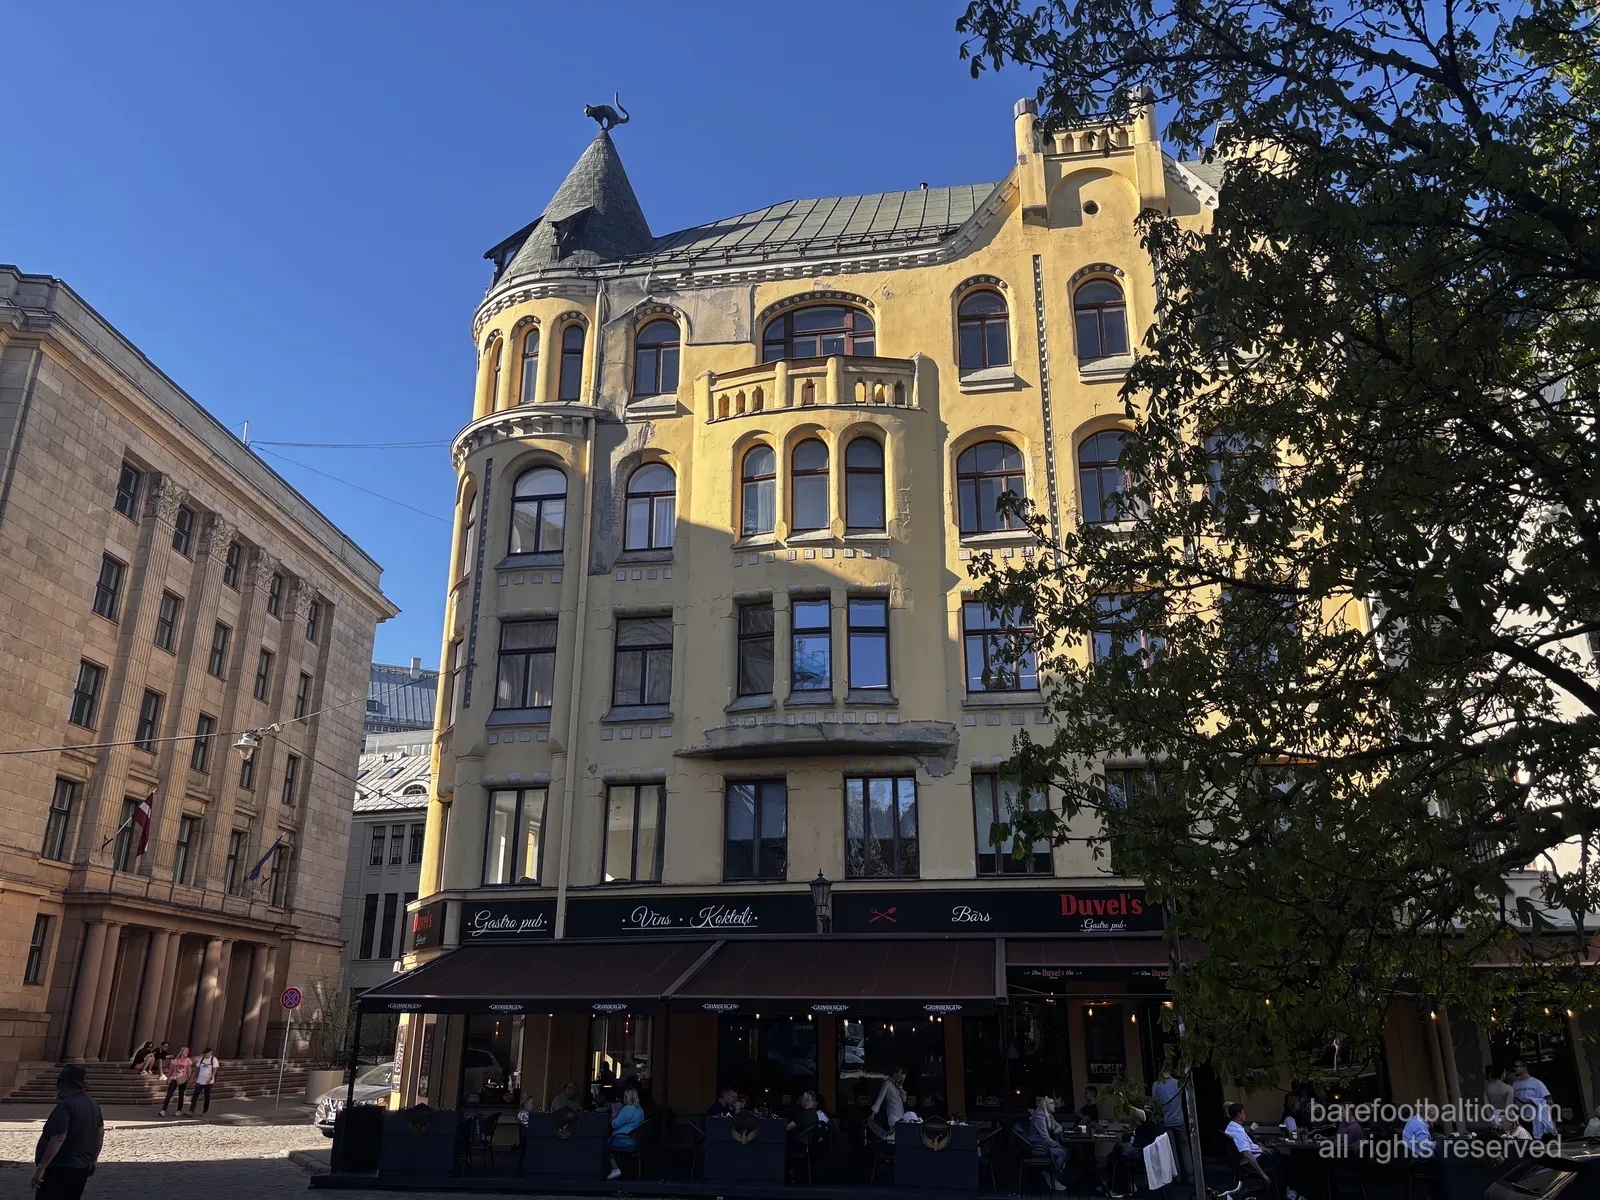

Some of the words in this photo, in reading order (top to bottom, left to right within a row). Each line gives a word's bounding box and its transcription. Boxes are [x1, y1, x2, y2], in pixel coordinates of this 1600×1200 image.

[951, 905, 992, 922] Bārs
[1060, 893, 1143, 916] Duvel's
[472, 910, 517, 937] Gastro
[517, 913, 543, 934] pub
[631, 905, 671, 928] Vīns
[1083, 918, 1109, 932] Gastro
[1110, 920, 1124, 932] pub
